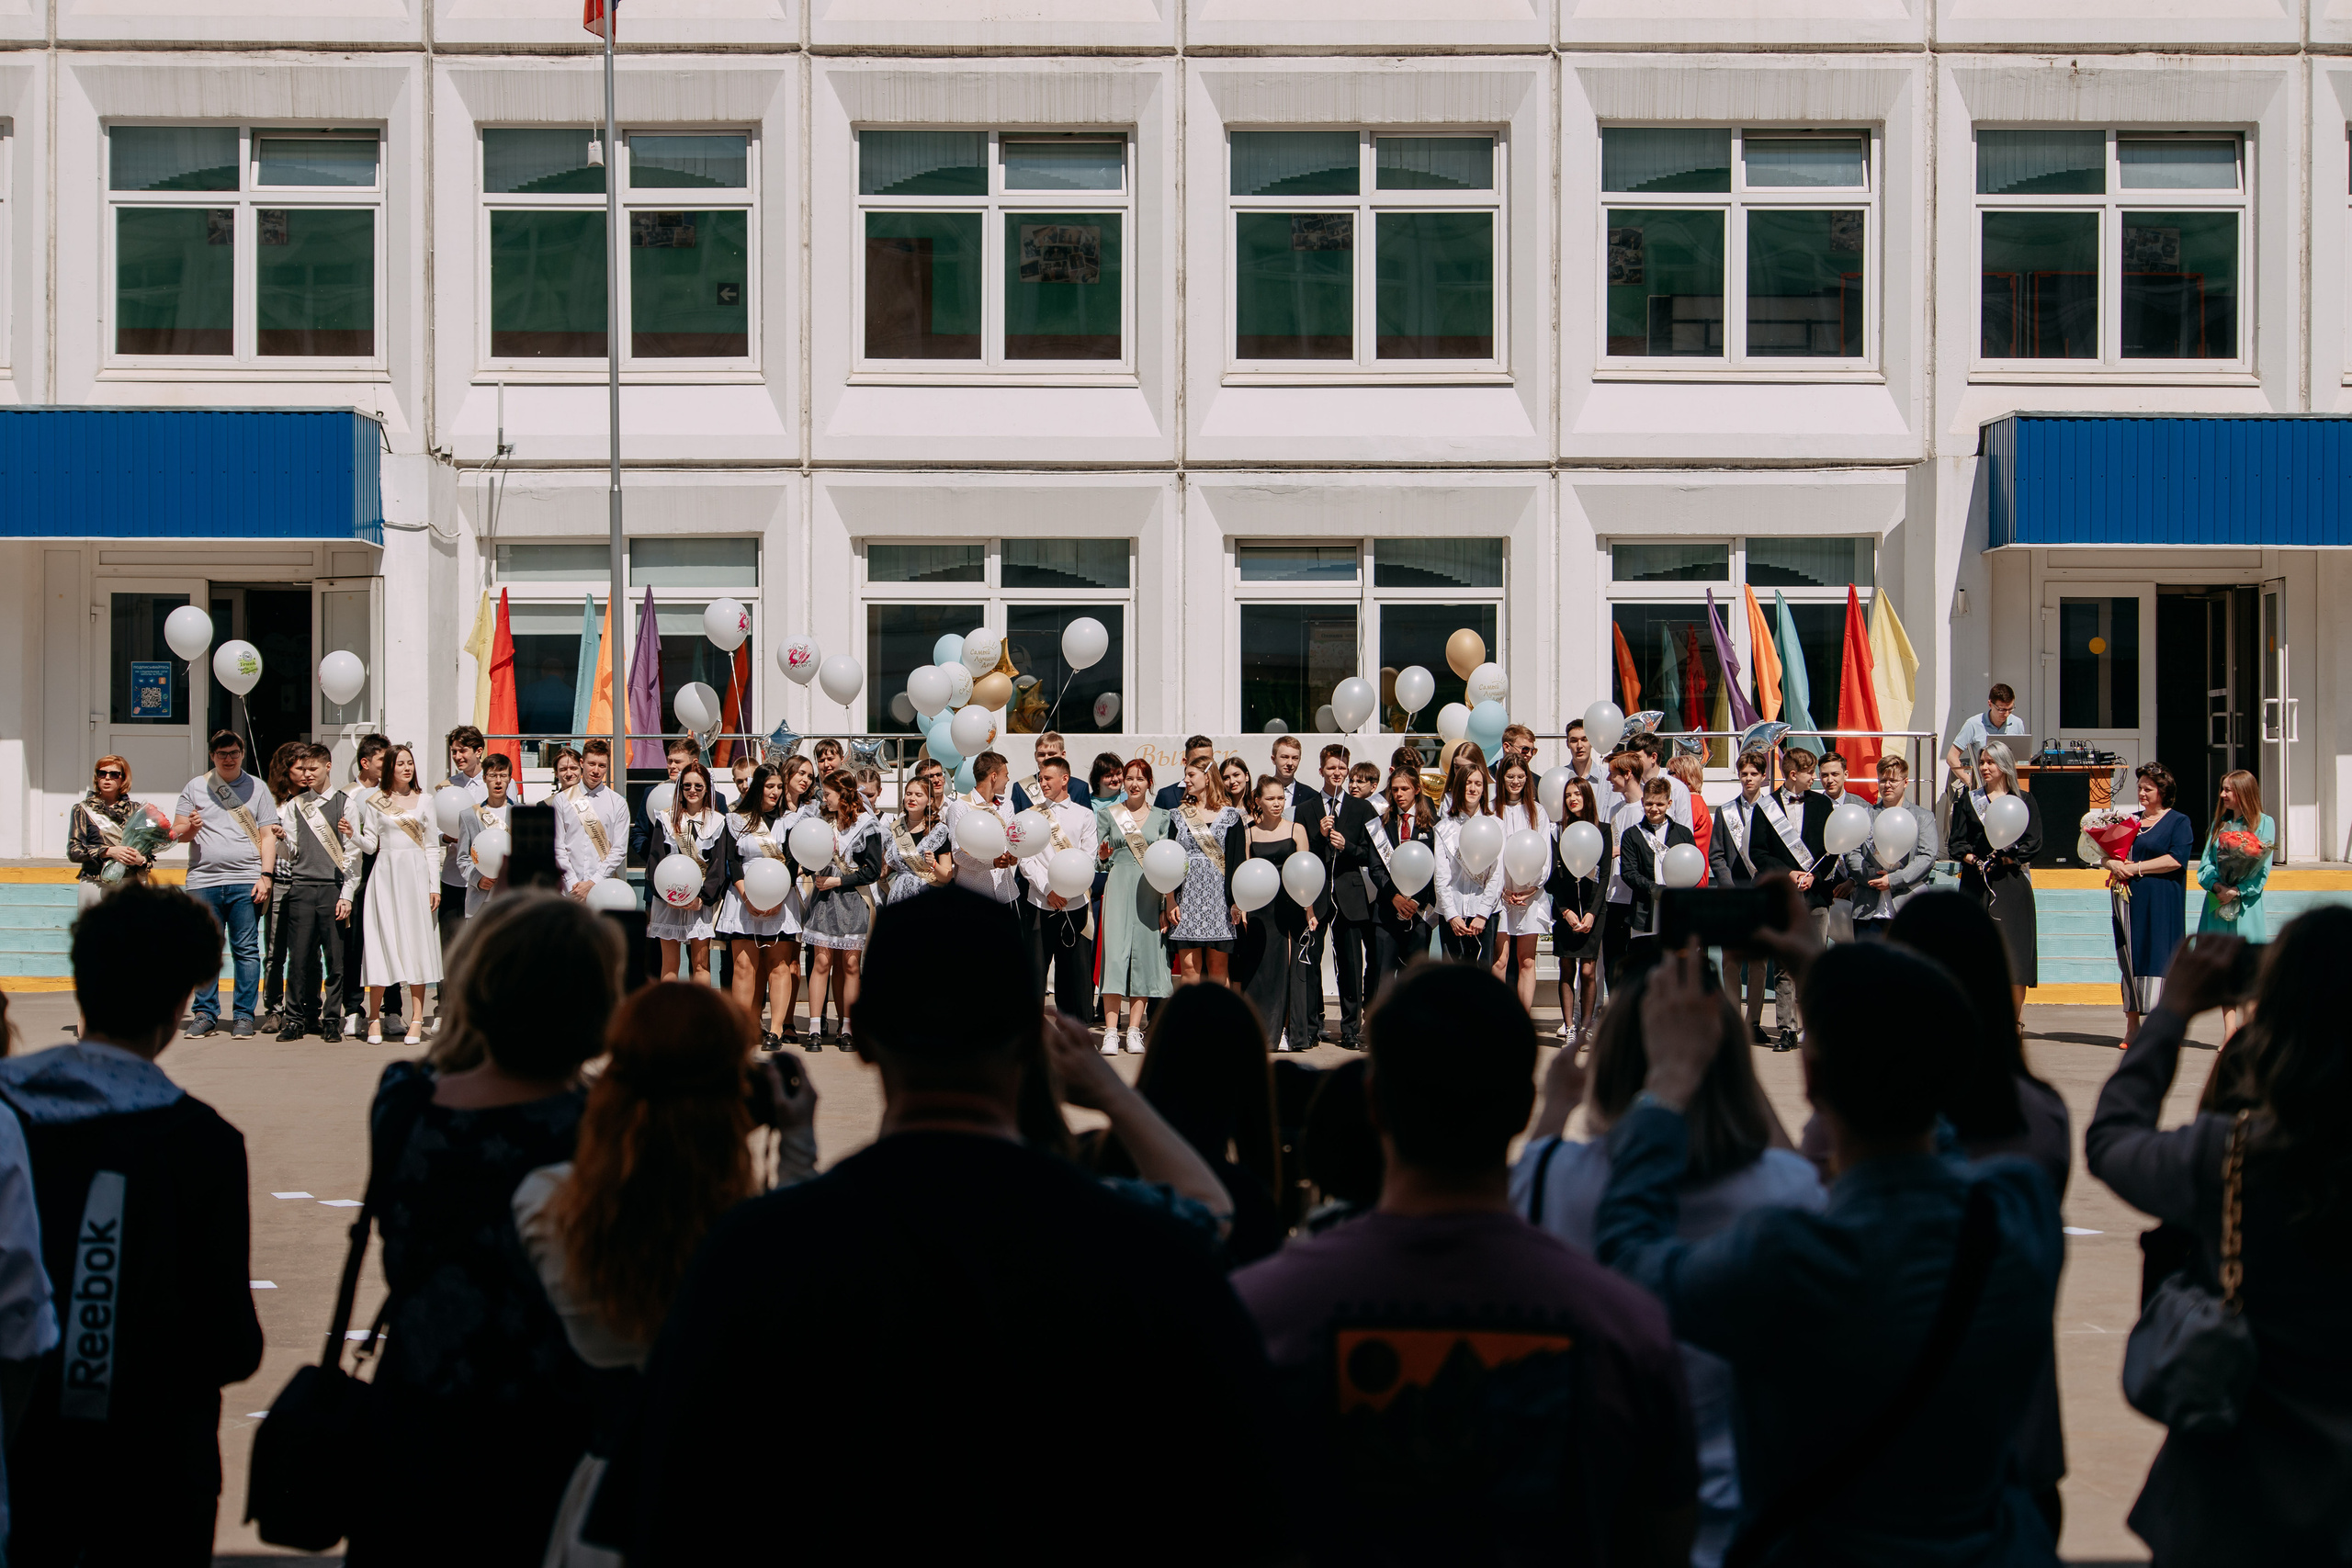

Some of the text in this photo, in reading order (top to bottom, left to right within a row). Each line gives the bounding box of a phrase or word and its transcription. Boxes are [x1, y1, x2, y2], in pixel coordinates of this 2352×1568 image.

[969, 648, 990, 656] Самый
[974, 654, 998, 663] Лучший
[1478, 682, 1499, 691] Самый
[1134, 743, 1238, 767] Выск
[65, 1217, 118, 1392] Reebok
